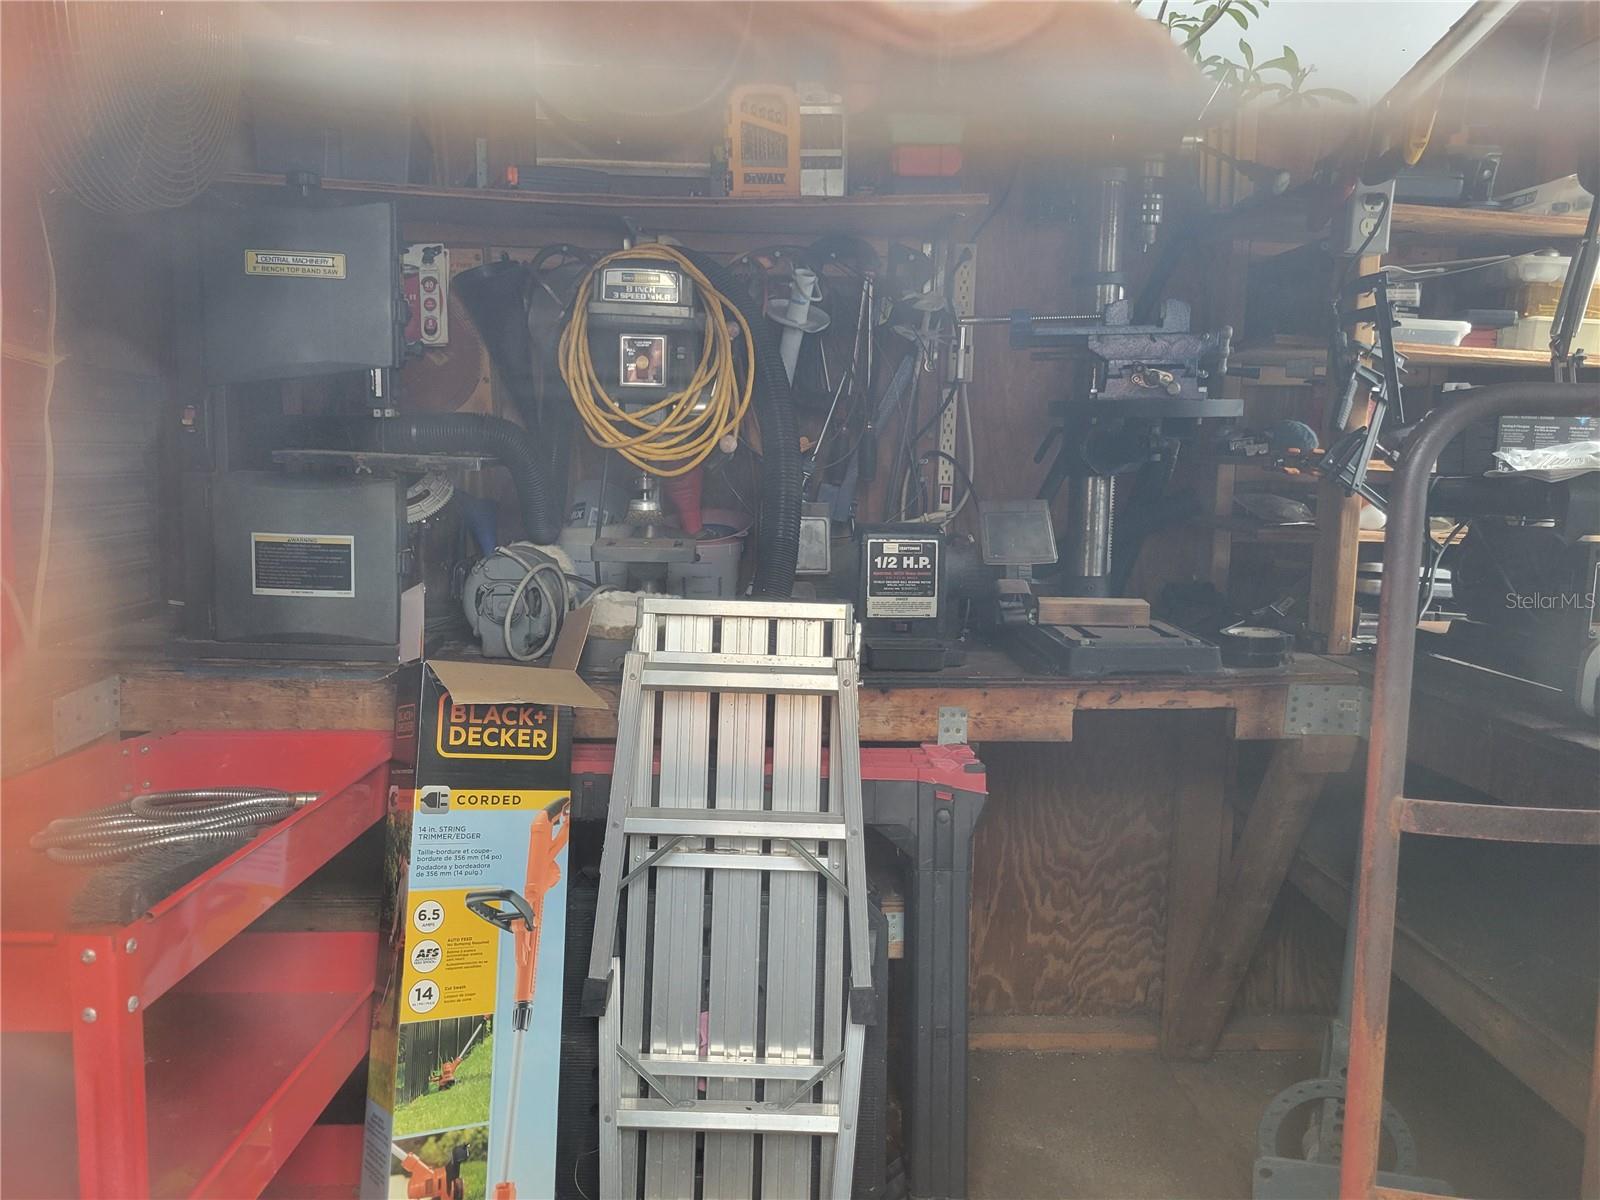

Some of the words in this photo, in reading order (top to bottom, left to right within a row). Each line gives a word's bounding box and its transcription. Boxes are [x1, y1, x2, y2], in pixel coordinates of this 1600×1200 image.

[260, 255, 288, 264] CENTRAL
[874, 556, 898, 569] 1/2
[902, 556, 931, 569] H.P.
[450, 704, 546, 726] BLACK+
[449, 726, 548, 748] DECKER
[457, 795, 522, 806] CORDED
[418, 909, 440, 921] 6.5
[416, 947, 440, 958] AFS
[414, 986, 433, 1002] 14
